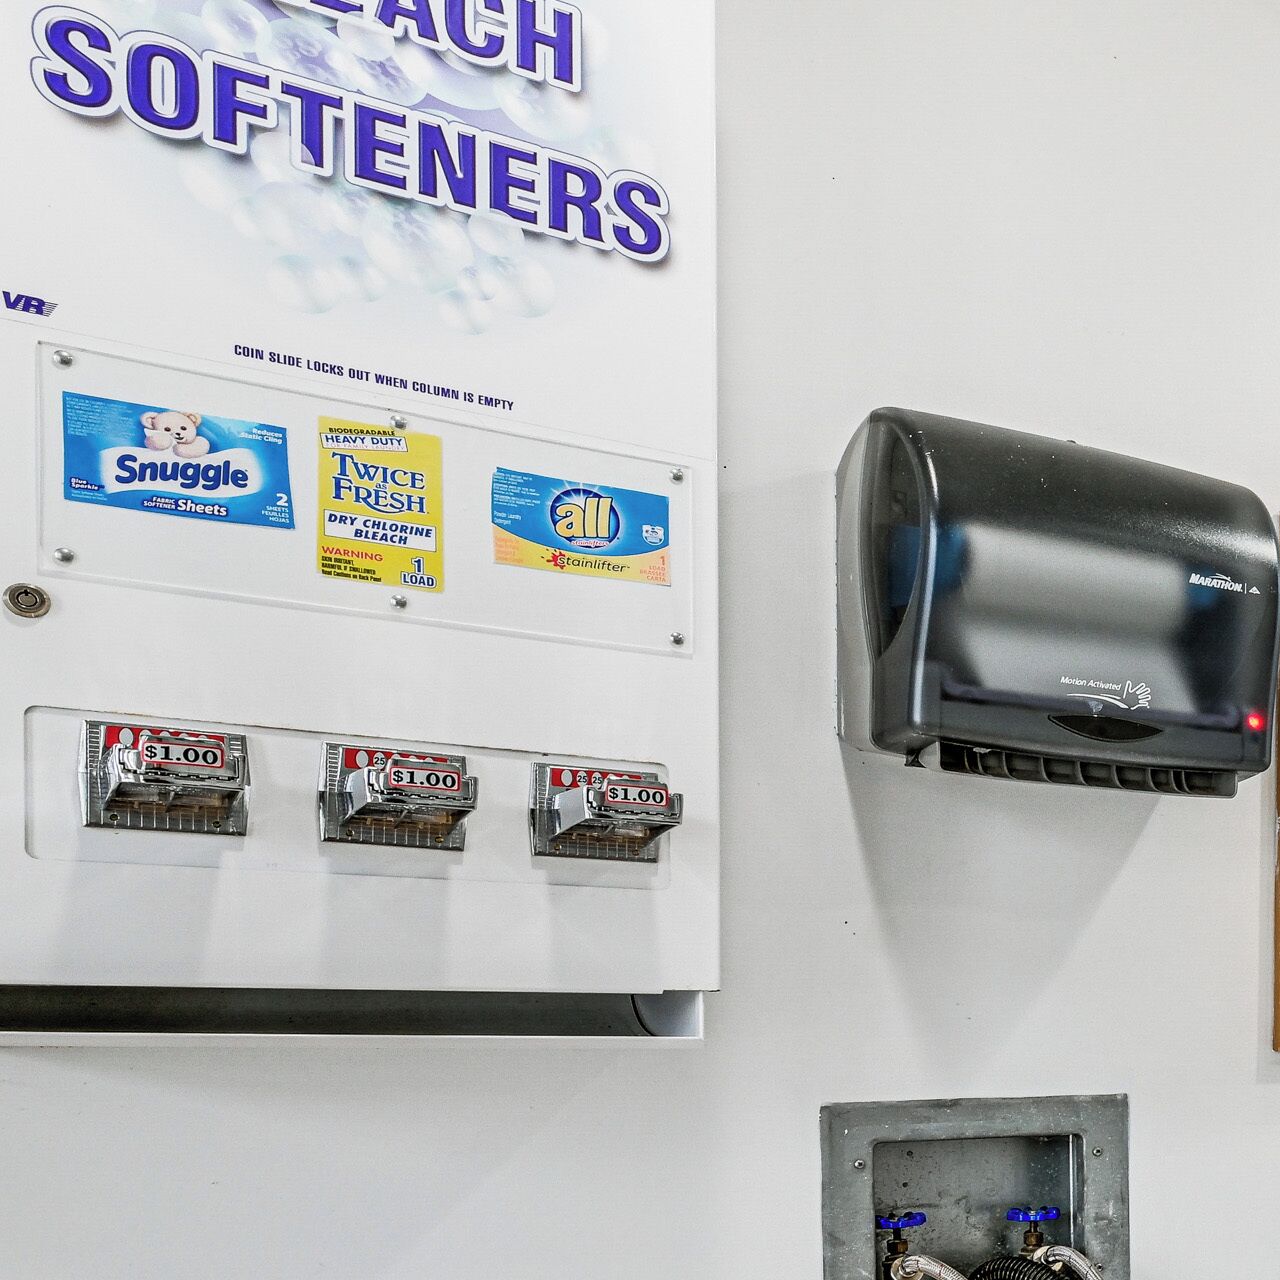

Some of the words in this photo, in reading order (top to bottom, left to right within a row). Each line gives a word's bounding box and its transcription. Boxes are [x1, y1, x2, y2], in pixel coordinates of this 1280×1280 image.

[310, 0, 575, 85] ACH
[42, 15, 665, 259] SOFTENERS
[2, 290, 54, 317] VR
[234, 344, 265, 360] COIN
[268, 351, 303, 368] SLIDE
[306, 359, 345, 377] LOCKS
[348, 367, 371, 382] OUT
[375, 373, 408, 390] WHEN
[412, 381, 460, 401] COLUMN
[463, 391, 475, 404] IS
[478, 395, 515, 412] EMPTY
[252, 427, 283, 437] Reduces
[328, 427, 396, 436] BIODEGRADABLE
[263, 435, 283, 444] Cling
[325, 435, 366, 444] HEAVY
[371, 437, 402, 446] DUTY
[114, 453, 249, 492] Snuggle
[331, 451, 426, 490] TWICE
[70, 483, 100, 491] Sparkle
[375, 482, 387, 491] as
[152, 496, 176, 505] FABRIC
[275, 493, 289, 506] 2
[331, 476, 427, 514] FRESH
[143, 501, 176, 510] SOFTENER
[177, 499, 228, 517] Sheets
[266, 505, 290, 513] SHEETS
[261, 510, 290, 519] FEUILLES
[269, 516, 290, 524] HOJAS
[554, 497, 613, 539] all
[328, 513, 358, 526] DRY
[362, 518, 433, 538] CHLORINE
[354, 528, 408, 545] BLEACH
[321, 546, 384, 562] WARNING
[412, 557, 423, 575] 1
[557, 555, 627, 573] stainlifter
[402, 573, 435, 587] LOAD
[1060, 676, 1087, 687] Motion
[1087, 679, 1122, 691] Activated
[144, 745, 219, 765] $1.00
[374, 756, 386, 766] 25
[392, 770, 457, 789] $1.00
[577, 775, 588, 784] 25
[592, 776, 603, 785] 25
[608, 787, 665, 804] $1.00
